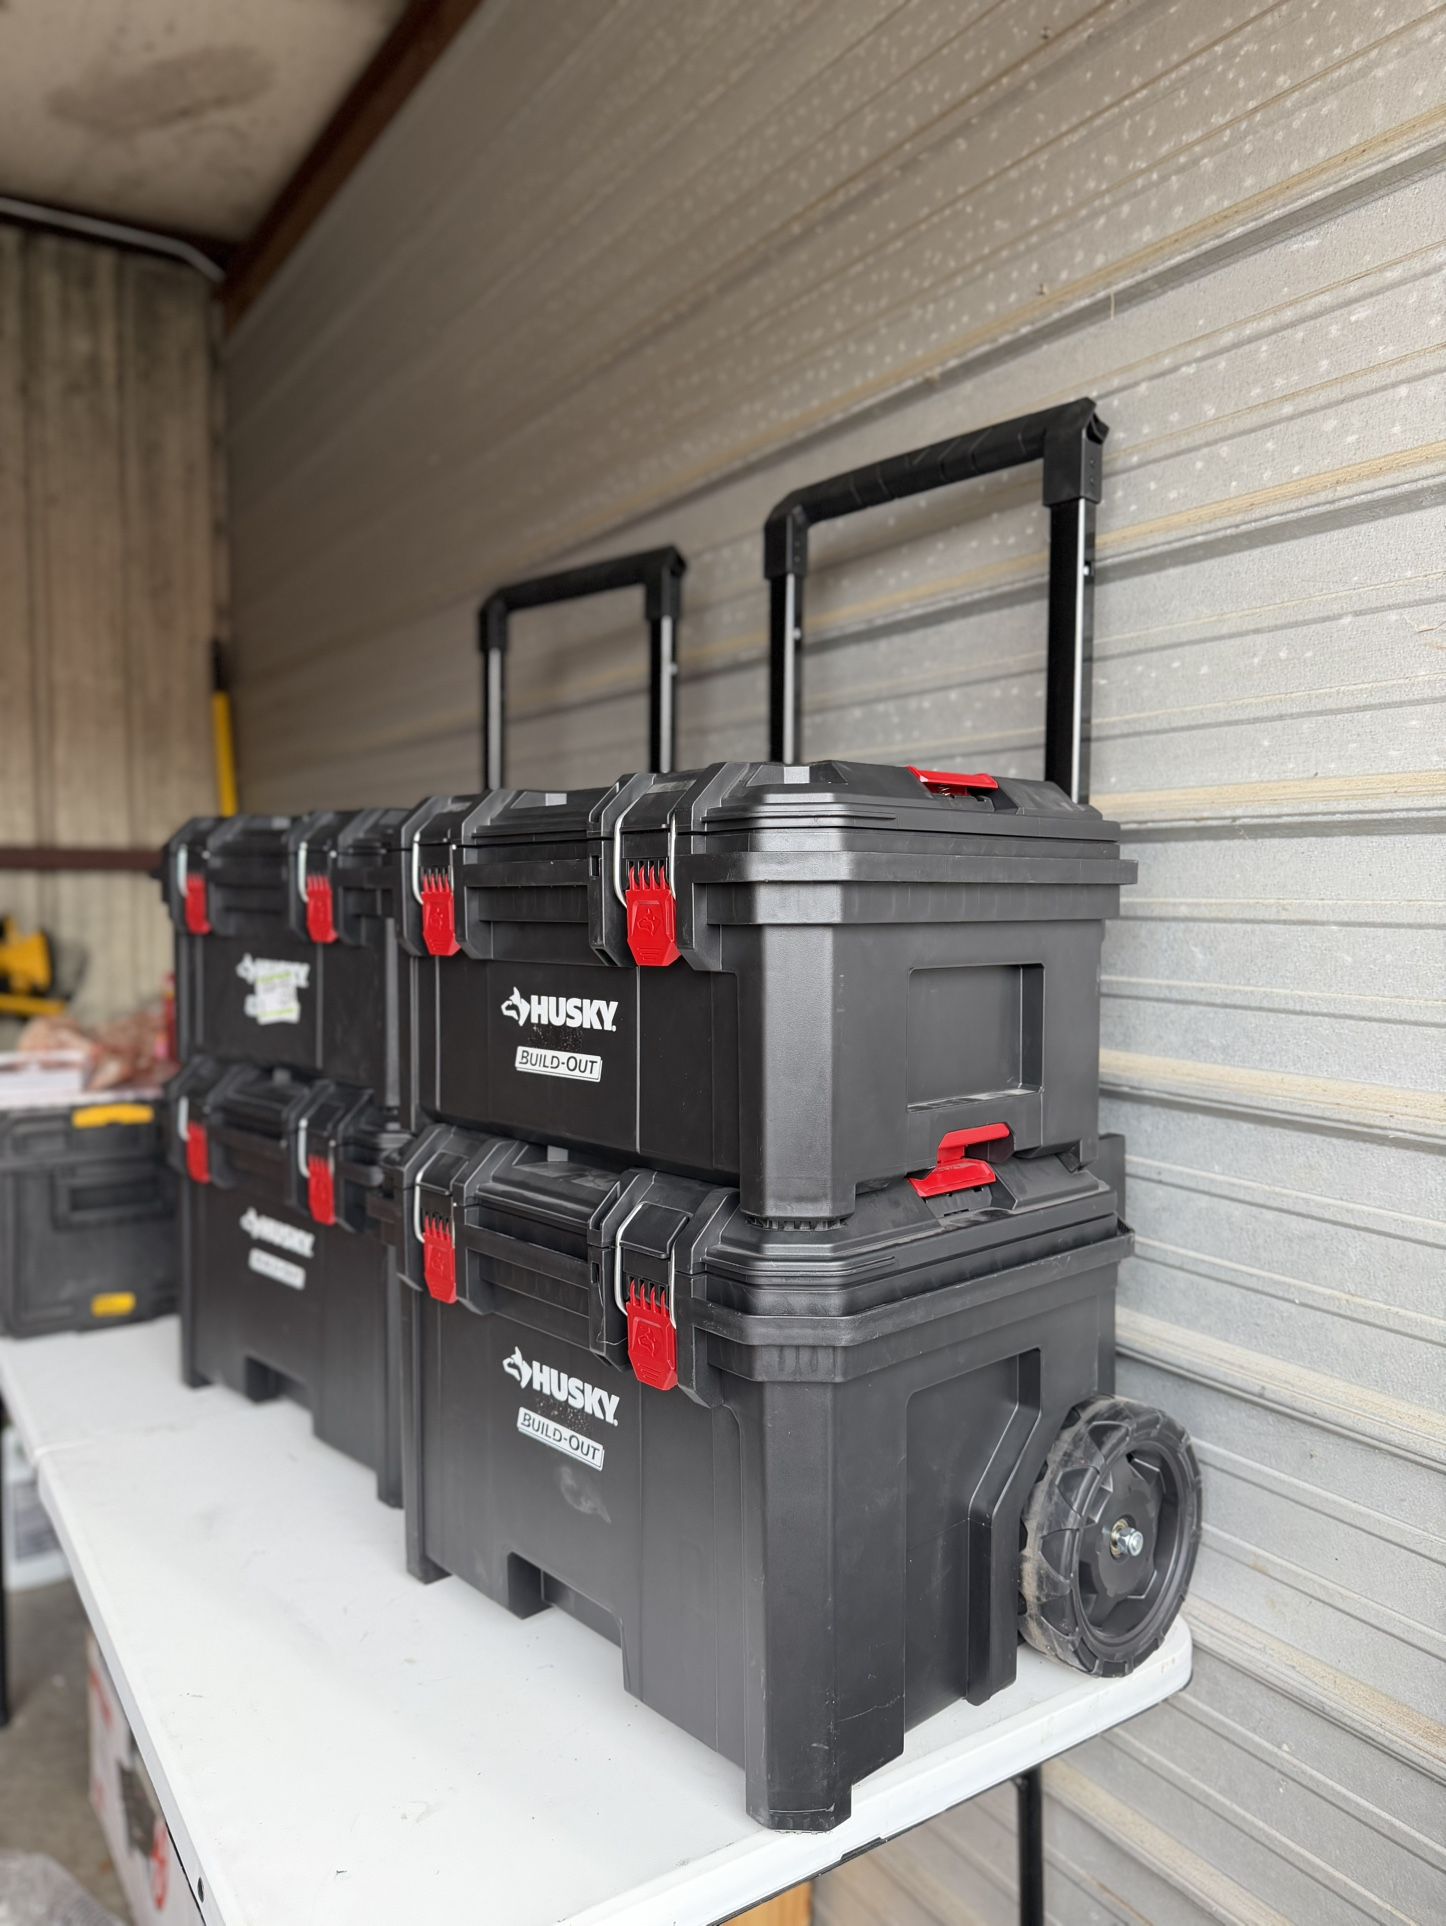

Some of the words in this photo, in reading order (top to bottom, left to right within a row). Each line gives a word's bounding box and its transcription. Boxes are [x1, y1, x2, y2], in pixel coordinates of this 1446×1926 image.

[530, 995, 618, 1031] HUSKY
[519, 1050, 598, 1075] BUILD-OUT
[532, 1361, 620, 1426] HUSKY
[520, 1411, 600, 1461] BUILD-OUT
